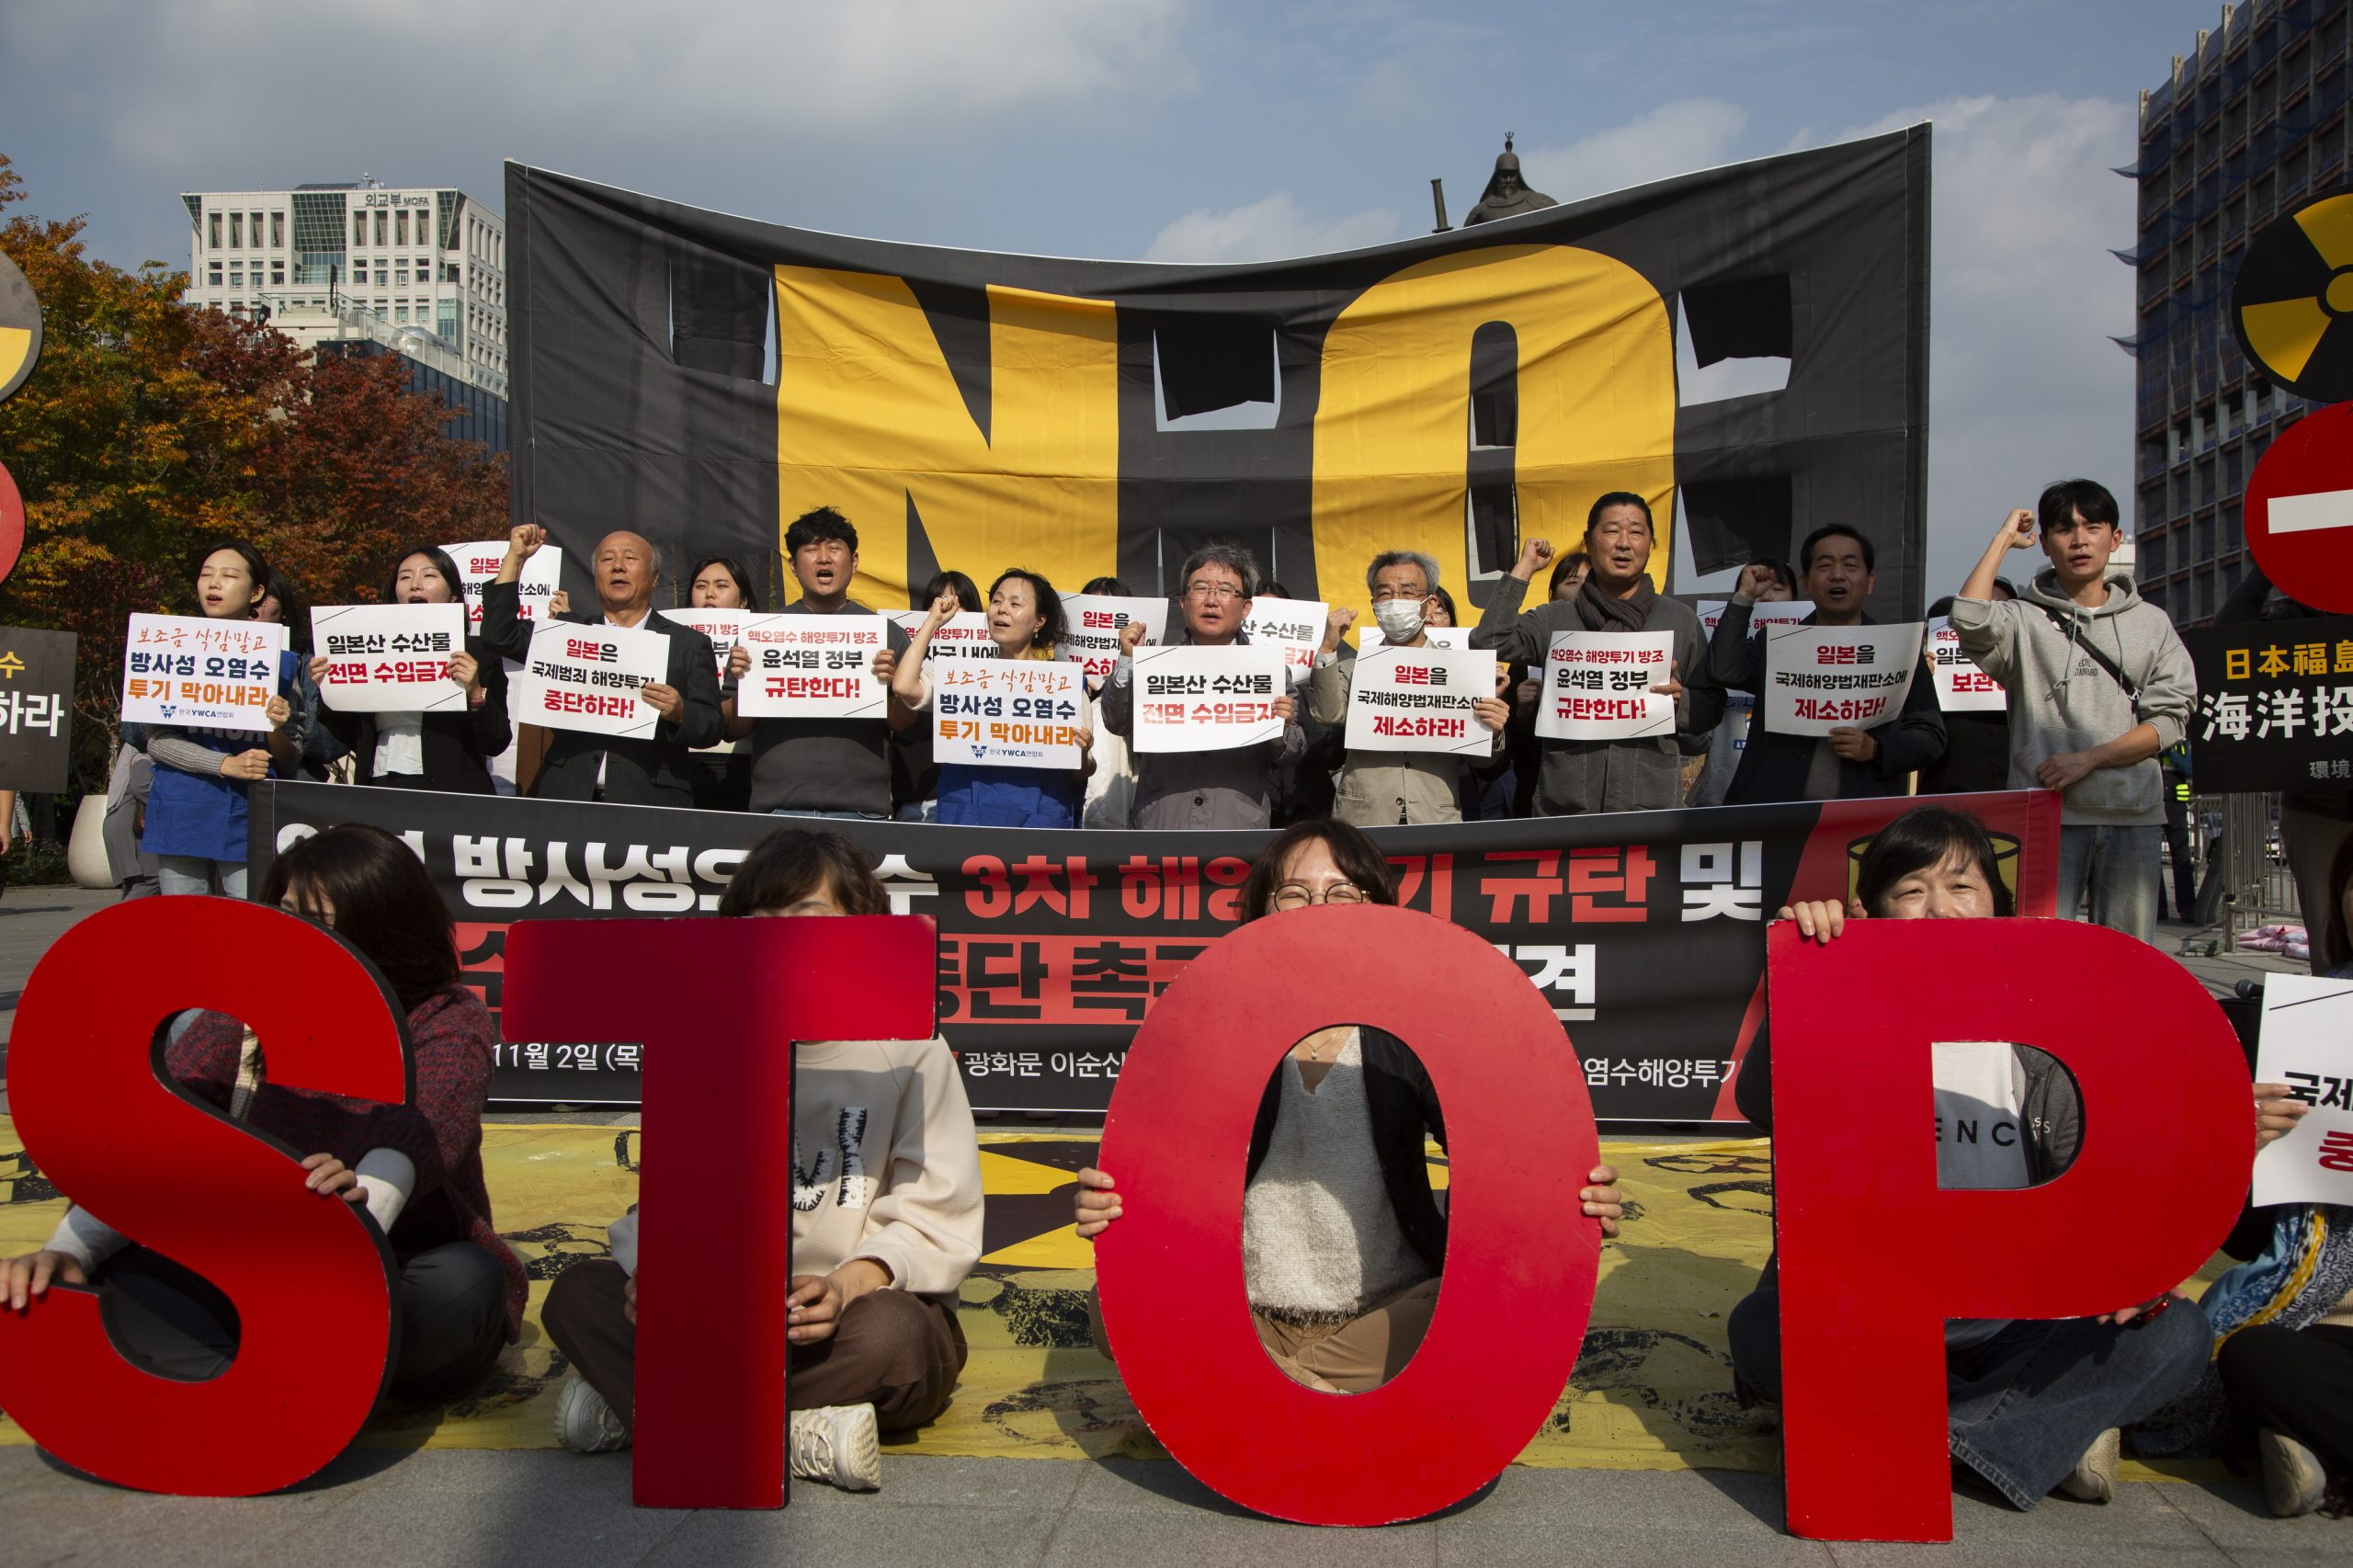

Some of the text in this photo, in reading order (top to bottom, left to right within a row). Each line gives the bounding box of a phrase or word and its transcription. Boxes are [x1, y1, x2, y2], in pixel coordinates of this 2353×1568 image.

[366, 193, 429, 208] 외교부 MOFA
[470, 557, 505, 574] 일본
[1083, 610, 1130, 630] 일본을
[137, 627, 188, 648] 보조금
[747, 630, 879, 644] 핵오염수 해양투기 방조
[1260, 621, 1314, 642] 수산물
[1936, 630, 1959, 642] 핵오
[326, 632, 451, 655] 일본산 수산물
[566, 638, 619, 664] 일본은
[1816, 644, 1876, 665] 일본을
[131, 652, 270, 680] 방사성 오염수
[762, 648, 864, 670] 윤석열 정부
[1551, 649, 1665, 664] 핵오염수 해양투기 방조
[2225, 640, 2353, 680] 日本福島
[327, 662, 369, 684] 전면
[531, 660, 587, 685] 국제범죄
[944, 668, 994, 688] 보조금
[1394, 664, 1449, 686] 일본을
[1556, 668, 1648, 691] 윤석열 정부
[1775, 669, 1908, 690] 국제해양법재판소에
[1951, 673, 2006, 692] 보관
[128, 678, 270, 707] 투기 막아내라
[765, 676, 860, 699] 규탄한다!
[1146, 674, 1273, 695] 일본산 수산물
[543, 688, 635, 720] 중단하라!
[939, 693, 1076, 721] 방사성 오염수
[1142, 702, 1276, 724] 전면 수입금지
[1556, 697, 1647, 721] 규탄한다!
[1794, 697, 1887, 721] 제소하라!
[2201, 686, 2353, 742] 海洋投
[938, 720, 1075, 746] 투기 막아내라
[1372, 715, 1465, 738] 제소하라!
[453, 834, 939, 915] 방사성오수
[961, 854, 1098, 919] 3차
[1481, 845, 1656, 923] 규탄
[1680, 841, 1762, 922] 및
[492, 1042, 550, 1070] 11월
[555, 1044, 598, 1071] 2일
[605, 1043, 644, 1072] (목
[964, 1051, 1043, 1077] 광화문
[1581, 1057, 1743, 1088] 염수해양투기
